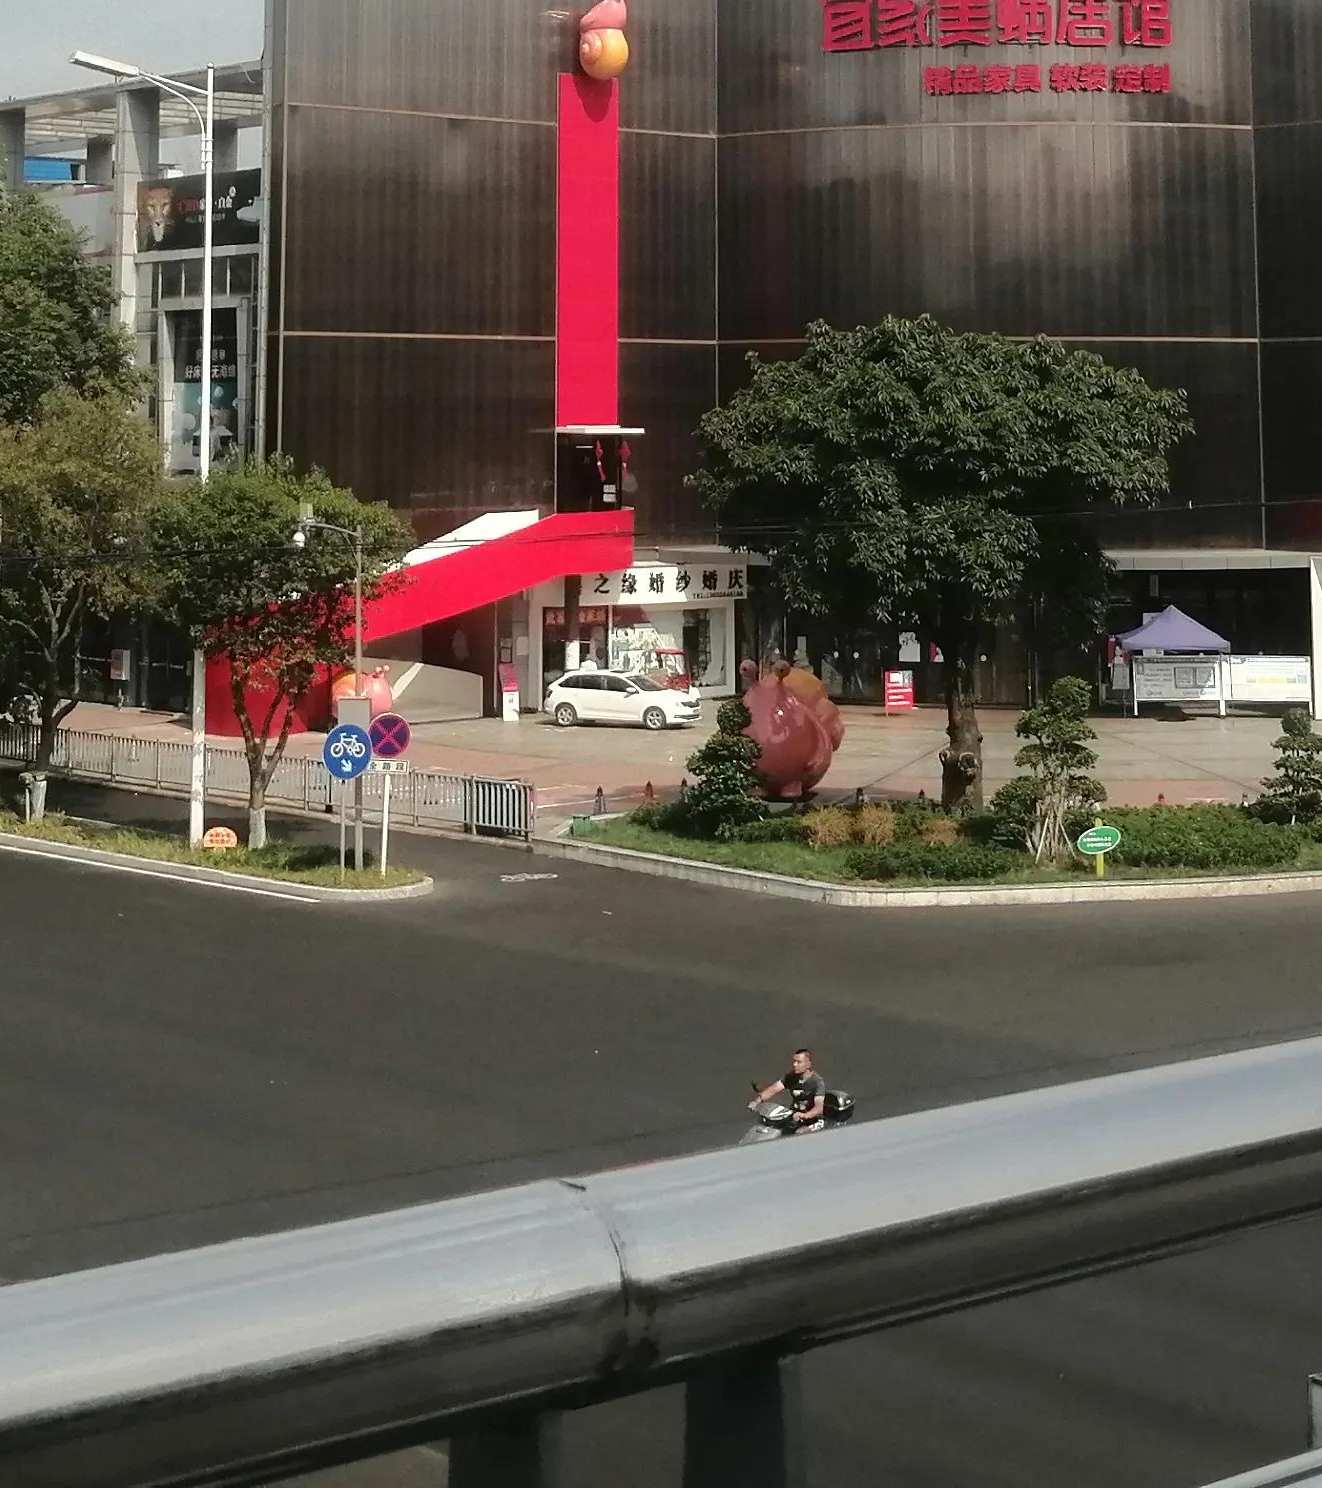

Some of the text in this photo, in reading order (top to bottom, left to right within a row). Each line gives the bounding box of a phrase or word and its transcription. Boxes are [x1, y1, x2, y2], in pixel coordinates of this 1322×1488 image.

[569, 568, 744, 595] 之缘婚纱婚庆
